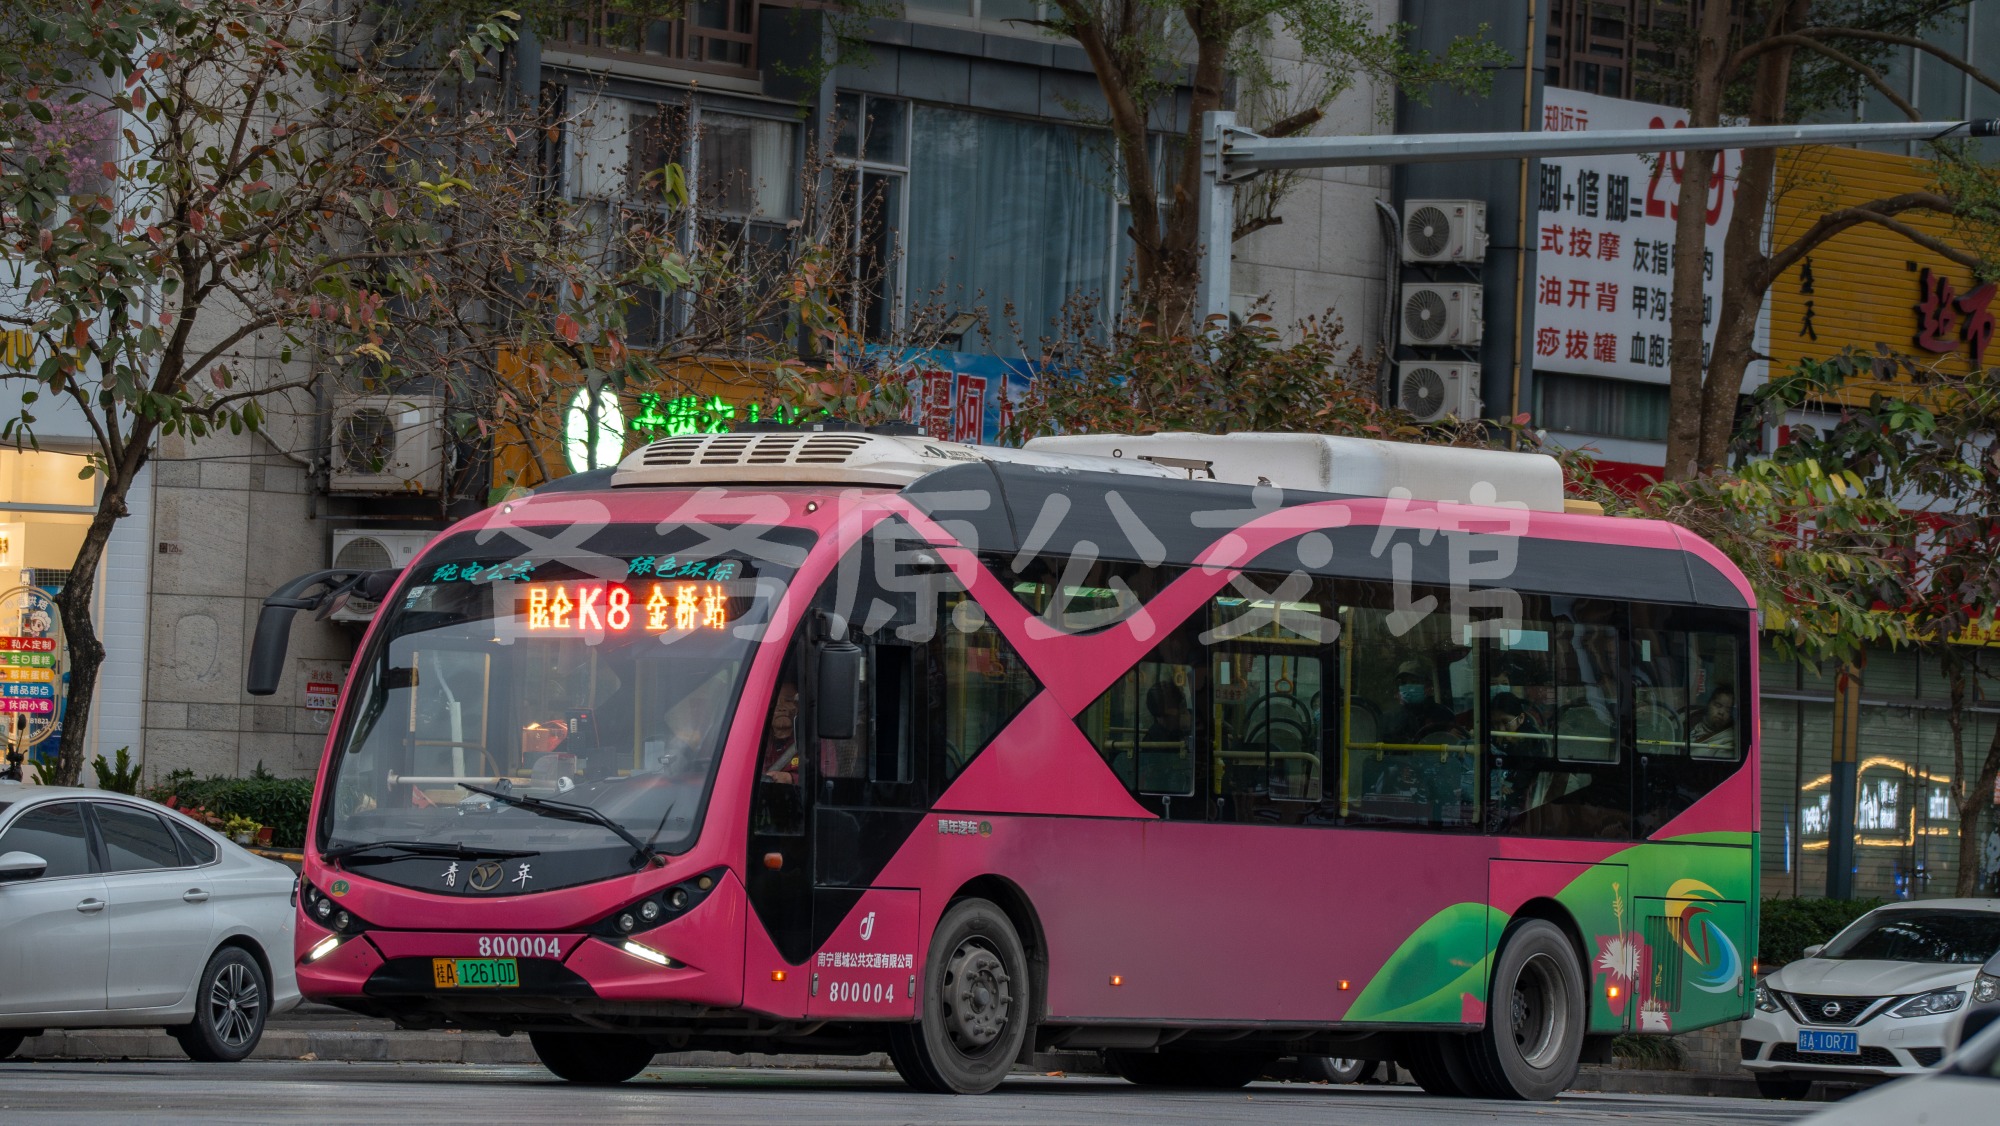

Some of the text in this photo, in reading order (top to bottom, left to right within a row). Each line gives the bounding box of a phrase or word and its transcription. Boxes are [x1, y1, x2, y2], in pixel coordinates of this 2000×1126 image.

[1541, 224, 1621, 261] 式按摩
[1538, 275, 1619, 313] 油开背
[1536, 327, 1617, 364] 痧拔罐
[432, 560, 536, 582] 纯电公交
[627, 555, 735, 582] 绿色环保
[578, 586, 631, 631] K8
[646, 585, 728, 630] 金桥站
[11, 639, 52, 650] 私人定制
[10, 654, 51, 666] 生日蛋糕
[9, 685, 49, 696] 精品甜点
[9, 700, 49, 711] 休闲小食
[938, 819, 978, 835] 青年汽车
[512, 862, 533, 889] 年
[478, 936, 561, 958] 800004
[817, 952, 913, 969] 南宁邕城公共交通有限公司
[829, 982, 894, 1004] 800004
